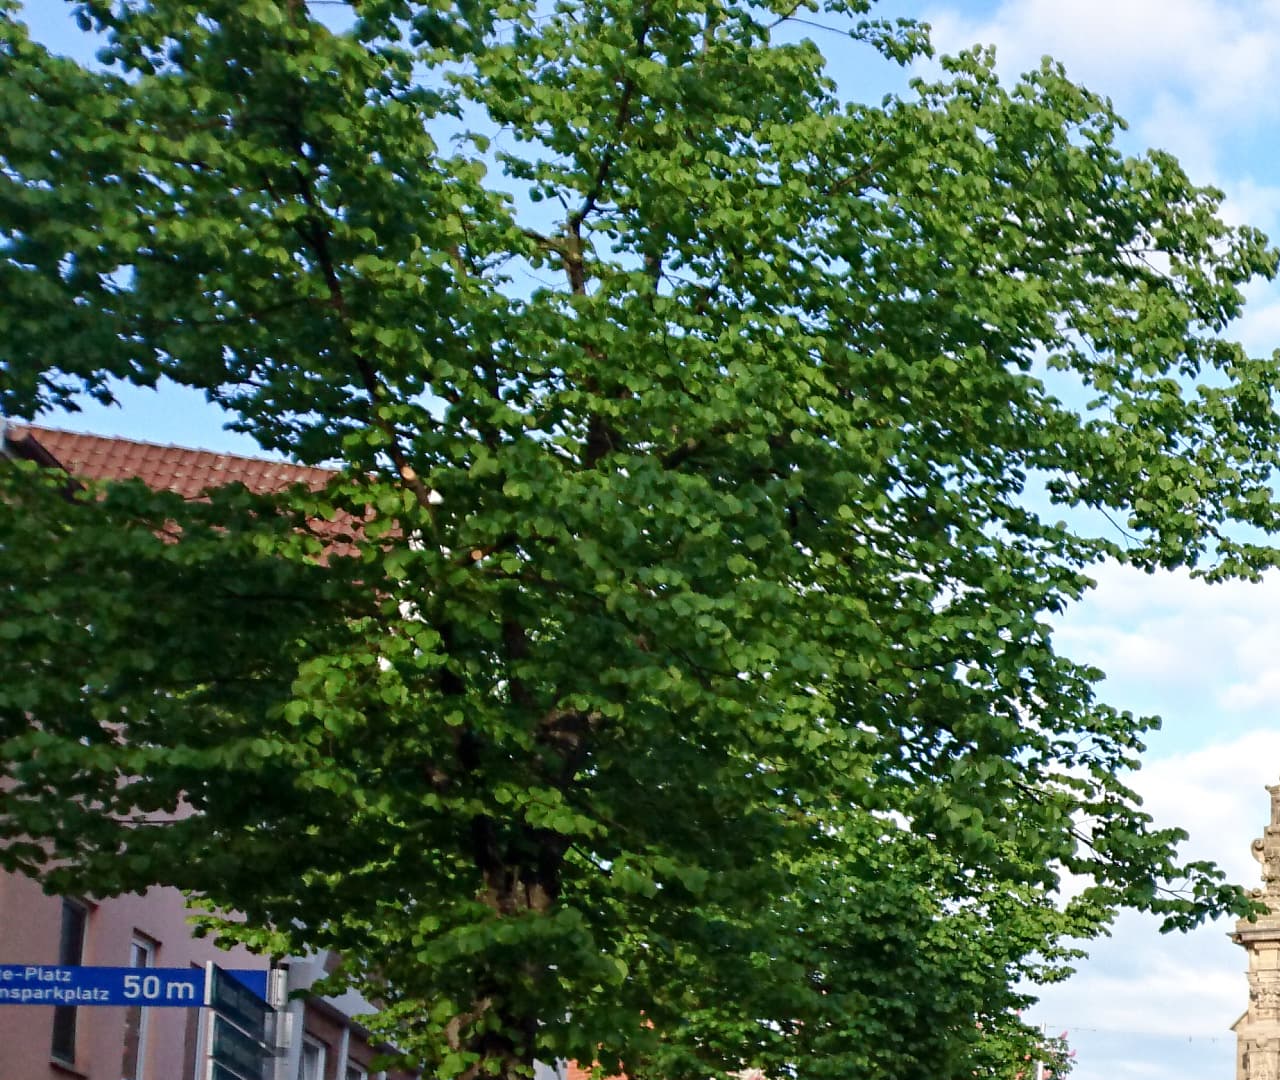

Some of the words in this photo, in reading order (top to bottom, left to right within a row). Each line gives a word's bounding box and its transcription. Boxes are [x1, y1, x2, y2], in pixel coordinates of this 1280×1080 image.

[0, 967, 72, 983] e-Platz
[0, 986, 110, 1003] nsparkplatz
[123, 975, 158, 999] 50
[166, 981, 194, 999] m
